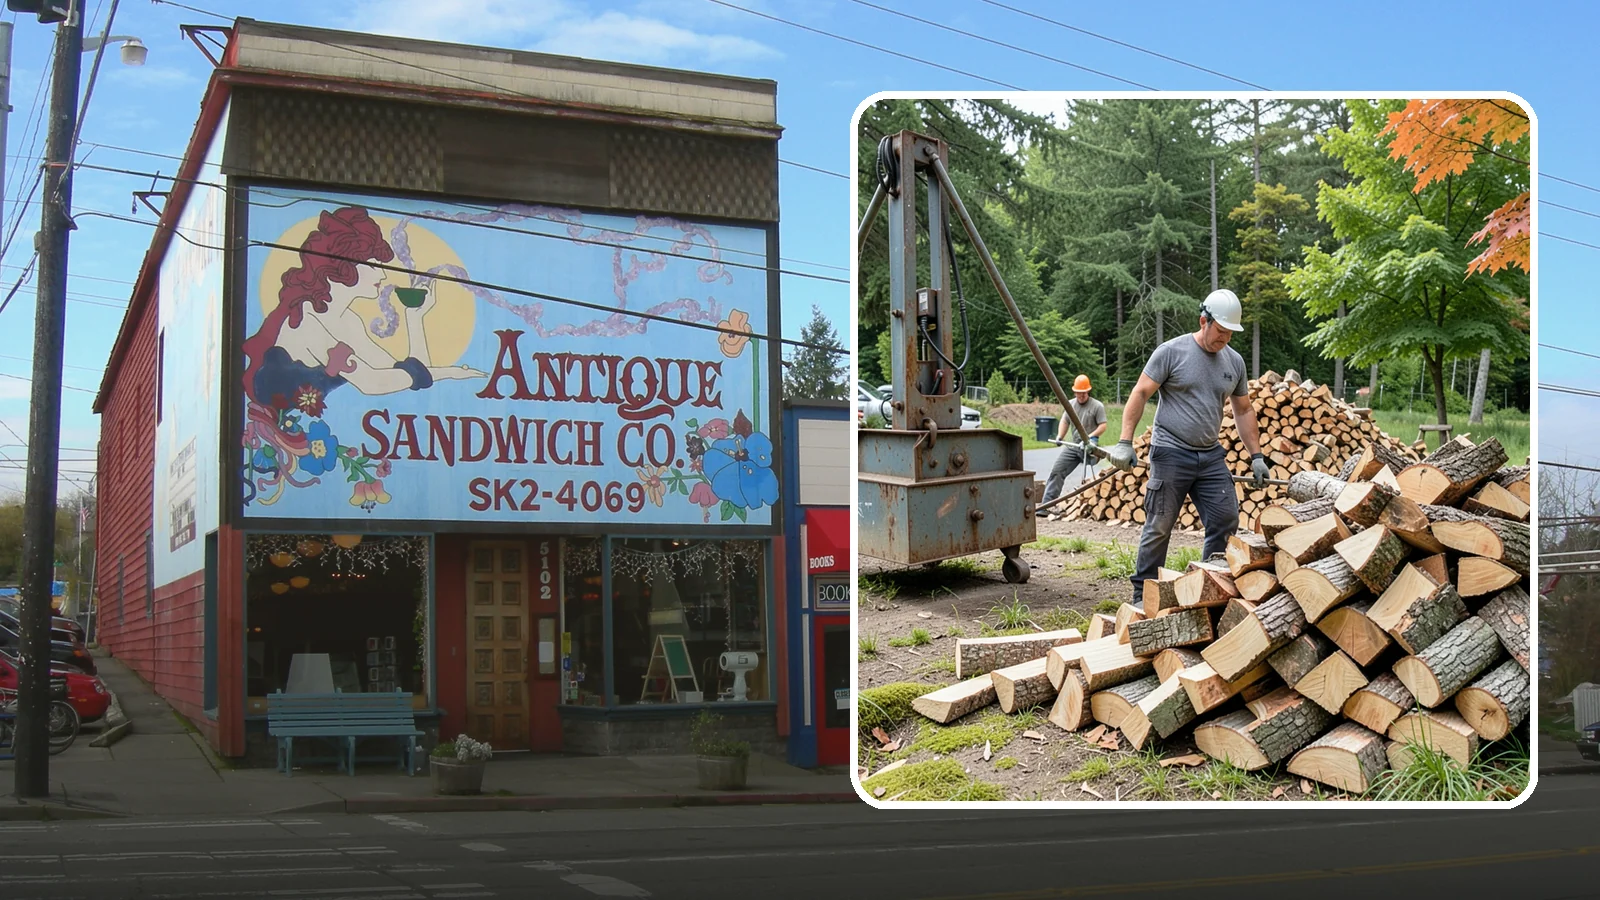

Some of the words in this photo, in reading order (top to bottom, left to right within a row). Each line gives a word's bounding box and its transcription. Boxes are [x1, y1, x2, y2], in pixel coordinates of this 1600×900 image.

[476, 329, 723, 421] ANTIQUE
[361, 409, 604, 467] SANDWICH
[617, 421, 685, 469] CO.
[468, 477, 645, 513] SK2-4069
[539, 541, 552, 600] 5102
[809, 555, 835, 569] BOOKS
